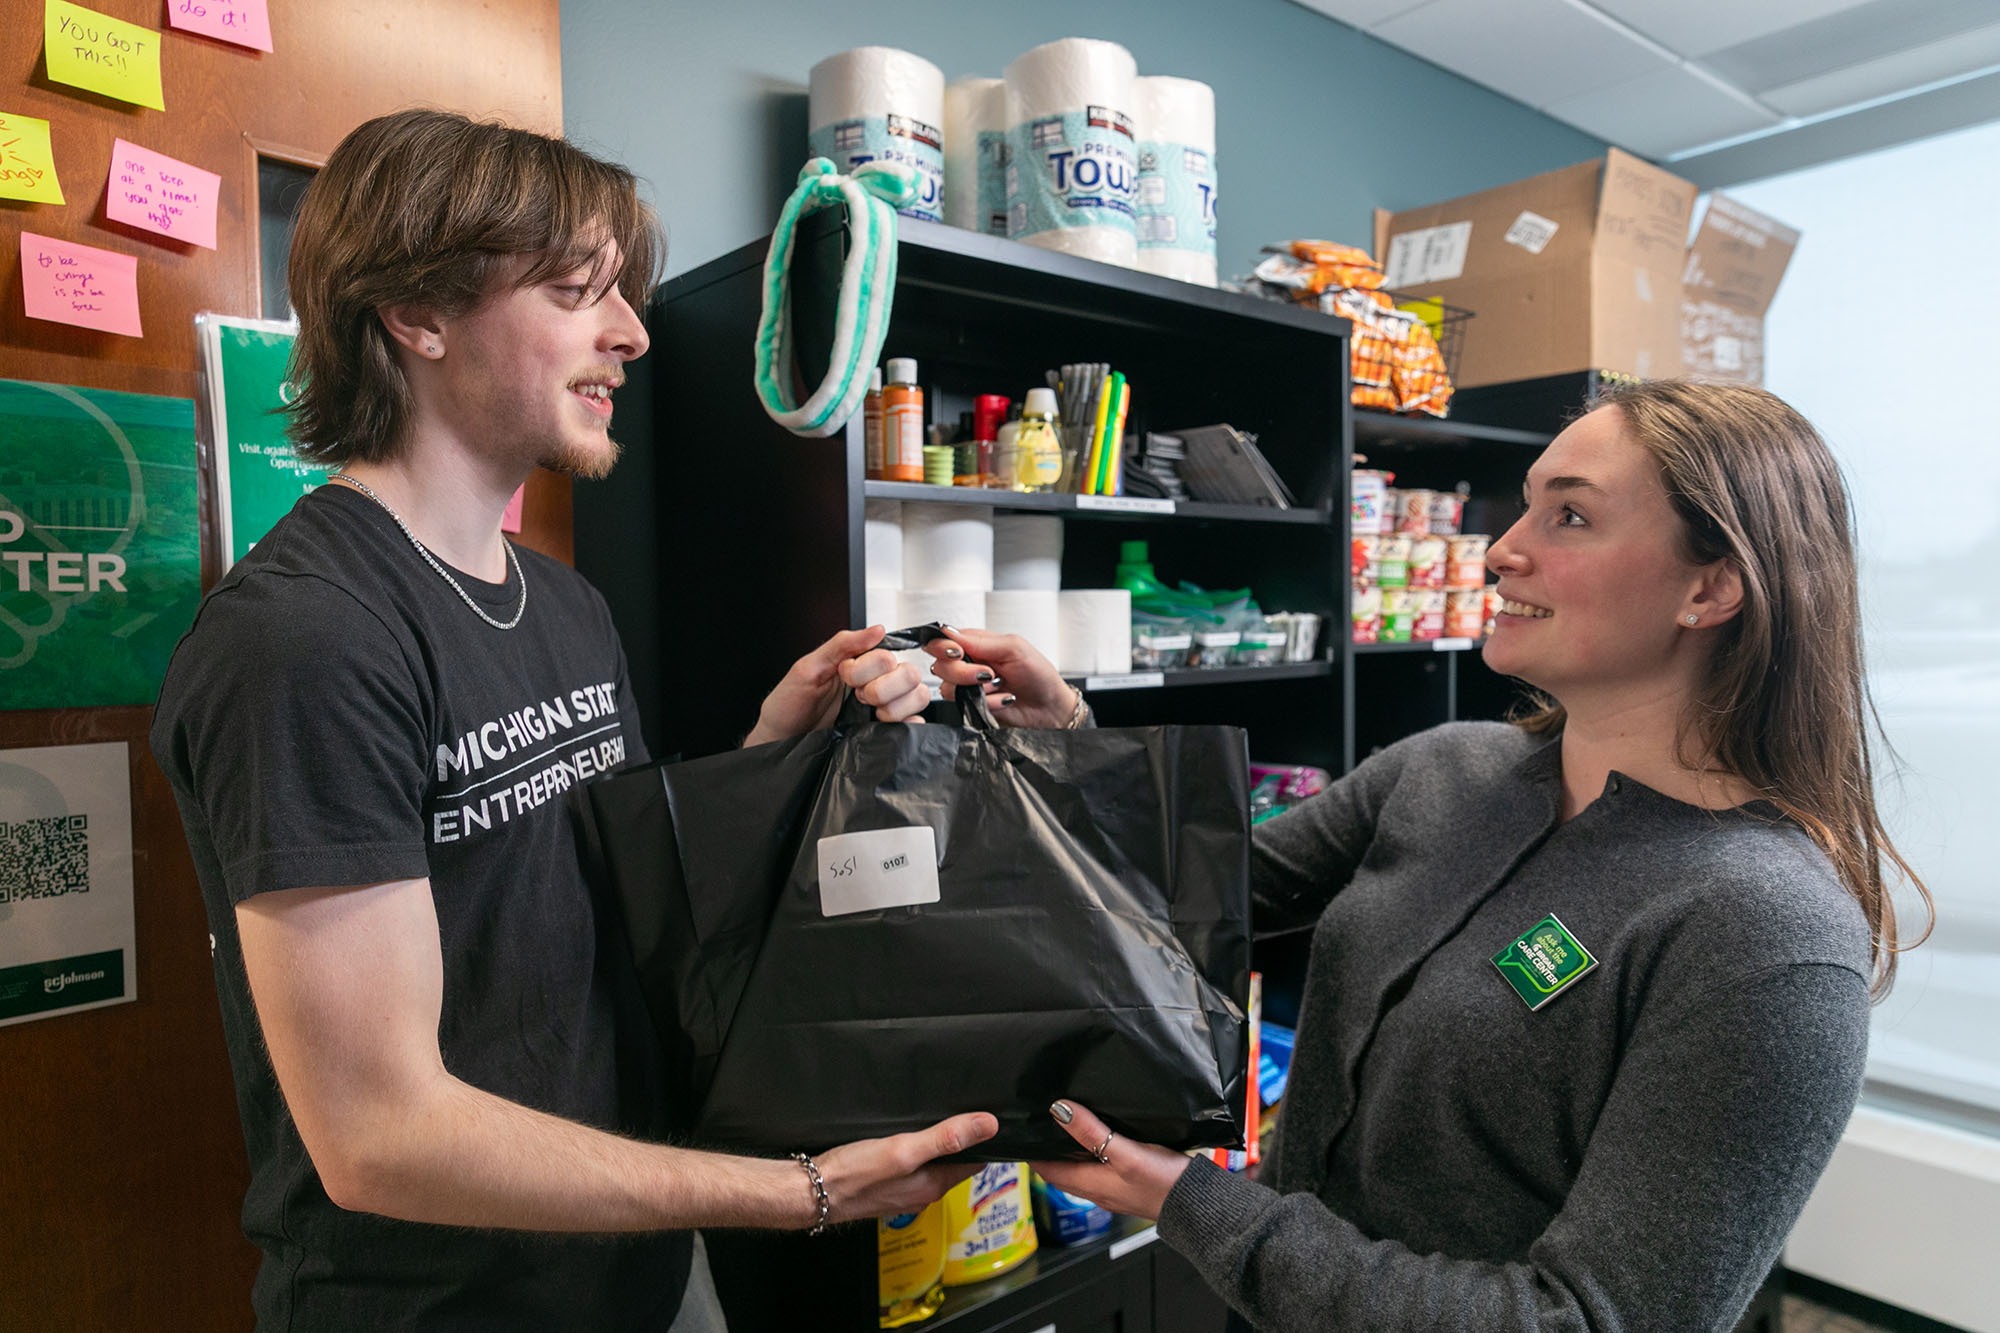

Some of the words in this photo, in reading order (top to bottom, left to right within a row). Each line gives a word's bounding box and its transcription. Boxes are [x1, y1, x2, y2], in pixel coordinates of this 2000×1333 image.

[60, 15, 98, 43] YOU
[106, 31, 145, 57] GOT
[436, 696, 574, 783] MICHIGN
[883, 856, 905, 870] 0107
[1517, 940, 1536, 960] CARE
[1532, 957, 1559, 986] CENTER
